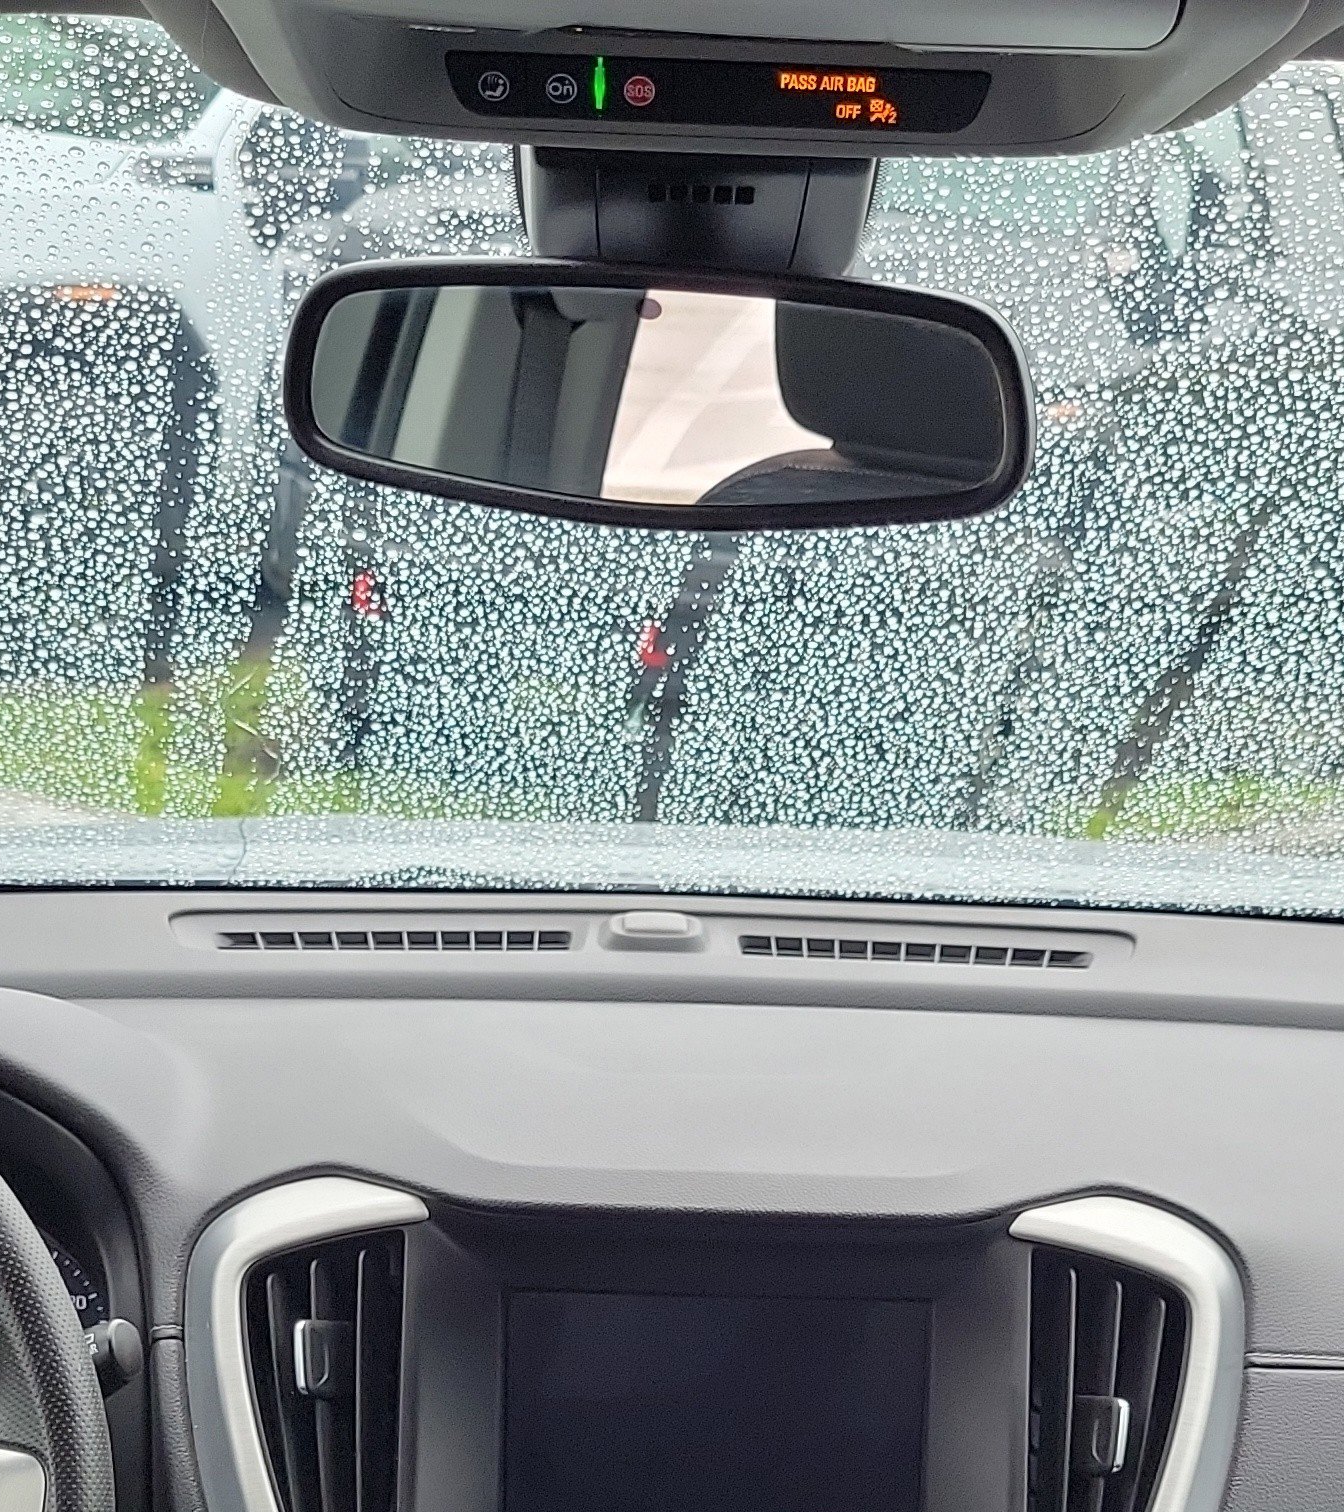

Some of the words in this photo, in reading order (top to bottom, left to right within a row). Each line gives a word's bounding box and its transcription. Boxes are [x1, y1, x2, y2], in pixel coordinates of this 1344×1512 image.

[780, 73, 817, 91] PASS
[819, 75, 844, 92] AIR
[846, 75, 876, 93] BAG
[626, 84, 652, 98] SOS
[835, 104, 862, 119] OFF
